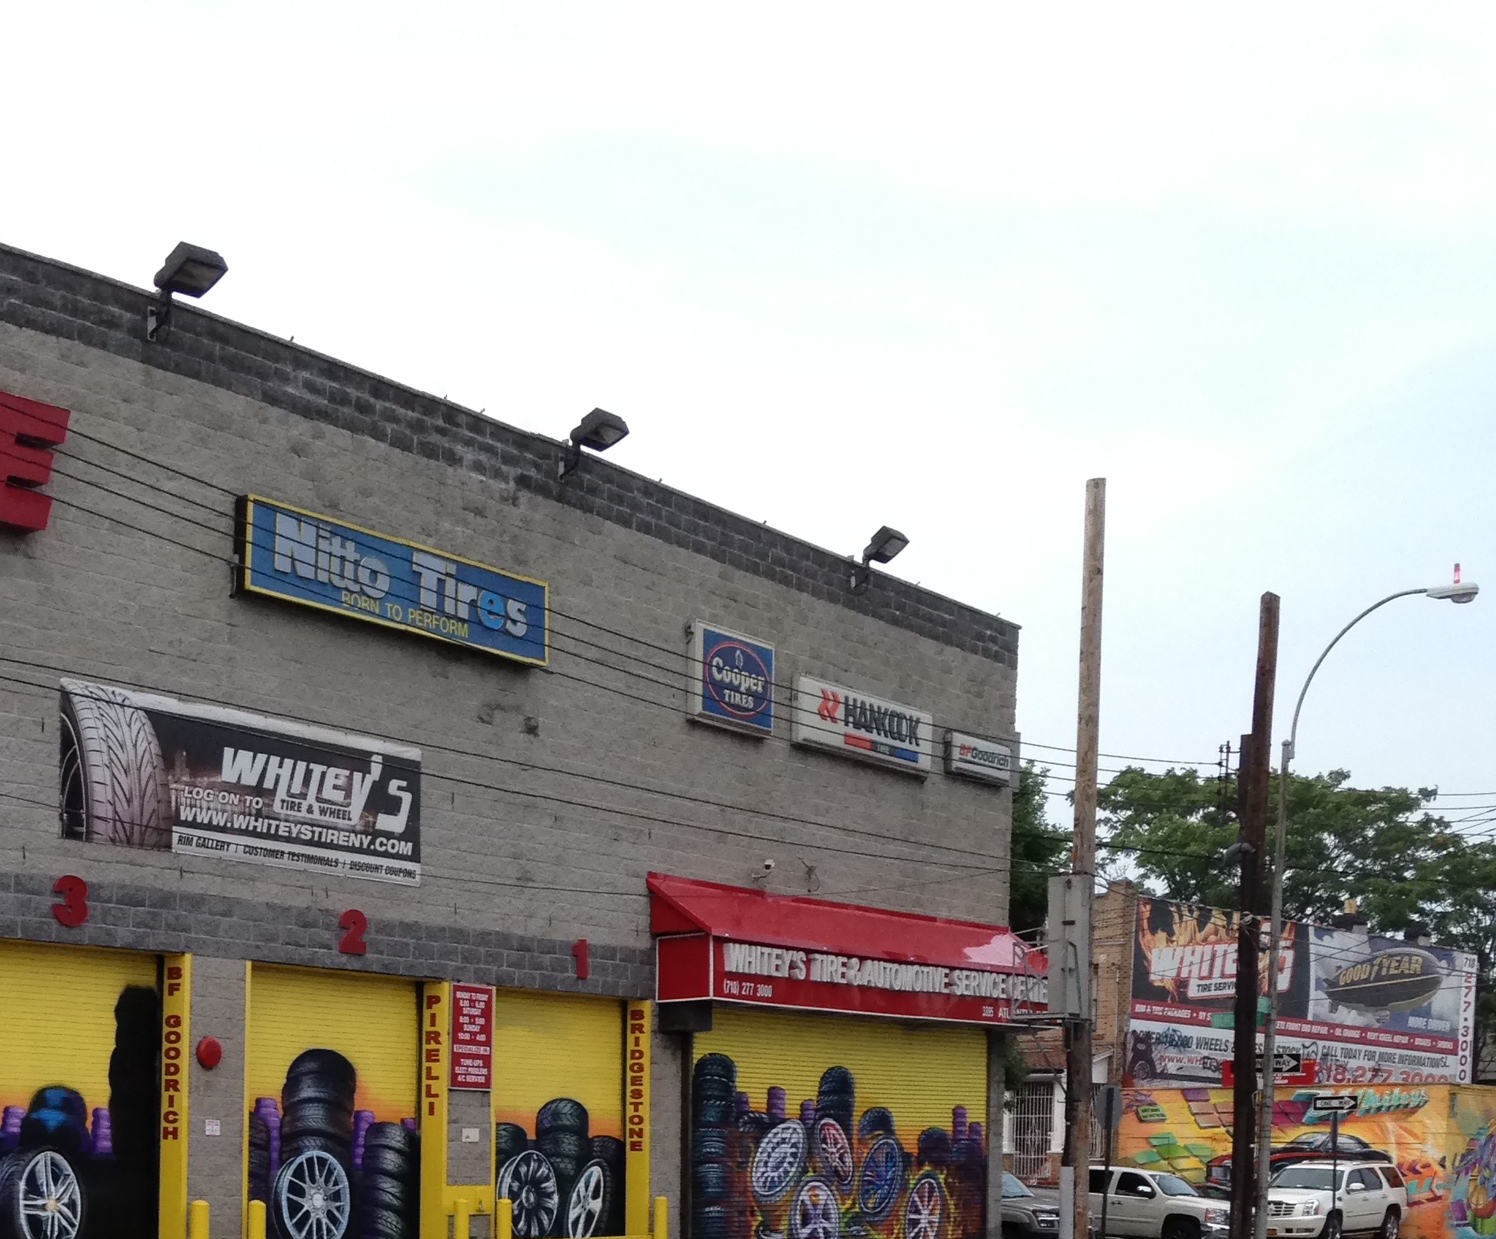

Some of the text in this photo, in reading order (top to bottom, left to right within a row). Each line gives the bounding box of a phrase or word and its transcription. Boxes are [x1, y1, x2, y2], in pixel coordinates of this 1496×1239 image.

[275, 512, 527, 637] Nitto Tires
[342, 589, 469, 638] BORN TO PERFORM
[712, 656, 766, 693] Cooper
[723, 689, 755, 709] TIRES
[844, 695, 922, 747] HANKOOK
[959, 743, 1009, 768] BFGoodrich
[183, 786, 263, 809] LOG ON TO
[221, 747, 413, 833] WHITEY'S
[179, 805, 413, 856] WWW.WHITEYSTIRENY.COM
[280, 800, 353, 822] TIRE & WHEEL
[177, 835, 231, 853] RIM GALLERY
[243, 845, 339, 868] CUSTOMER TESTIMONIALS
[349, 860, 417, 880] DISCOUNT COUPONS
[52, 874, 89, 927] 3
[338, 909, 367, 955] 2
[572, 938, 589, 980] 1
[723, 942, 807, 980] WHITEY'S
[811, 953, 848, 984] TIRE
[848, 957, 862, 986] &
[862, 959, 950, 993] AUTOMOTIVE
[952, 969, 1007, 998] SERVICE
[741, 983, 755, 996] 277
[756, 984, 773, 998] 3000
[1196, 981, 1236, 993] TIRE SERVI
[162, 966, 183, 1141] BF GOODRICH
[425, 995, 442, 1117] PIRELLI
[1196, 1037, 1230, 1052] WHEELS
[1321, 1045, 1440, 1068] CALL TODAY FOR MORE INFORMATION
[628, 1008, 645, 1153] BRIDGESTONE
